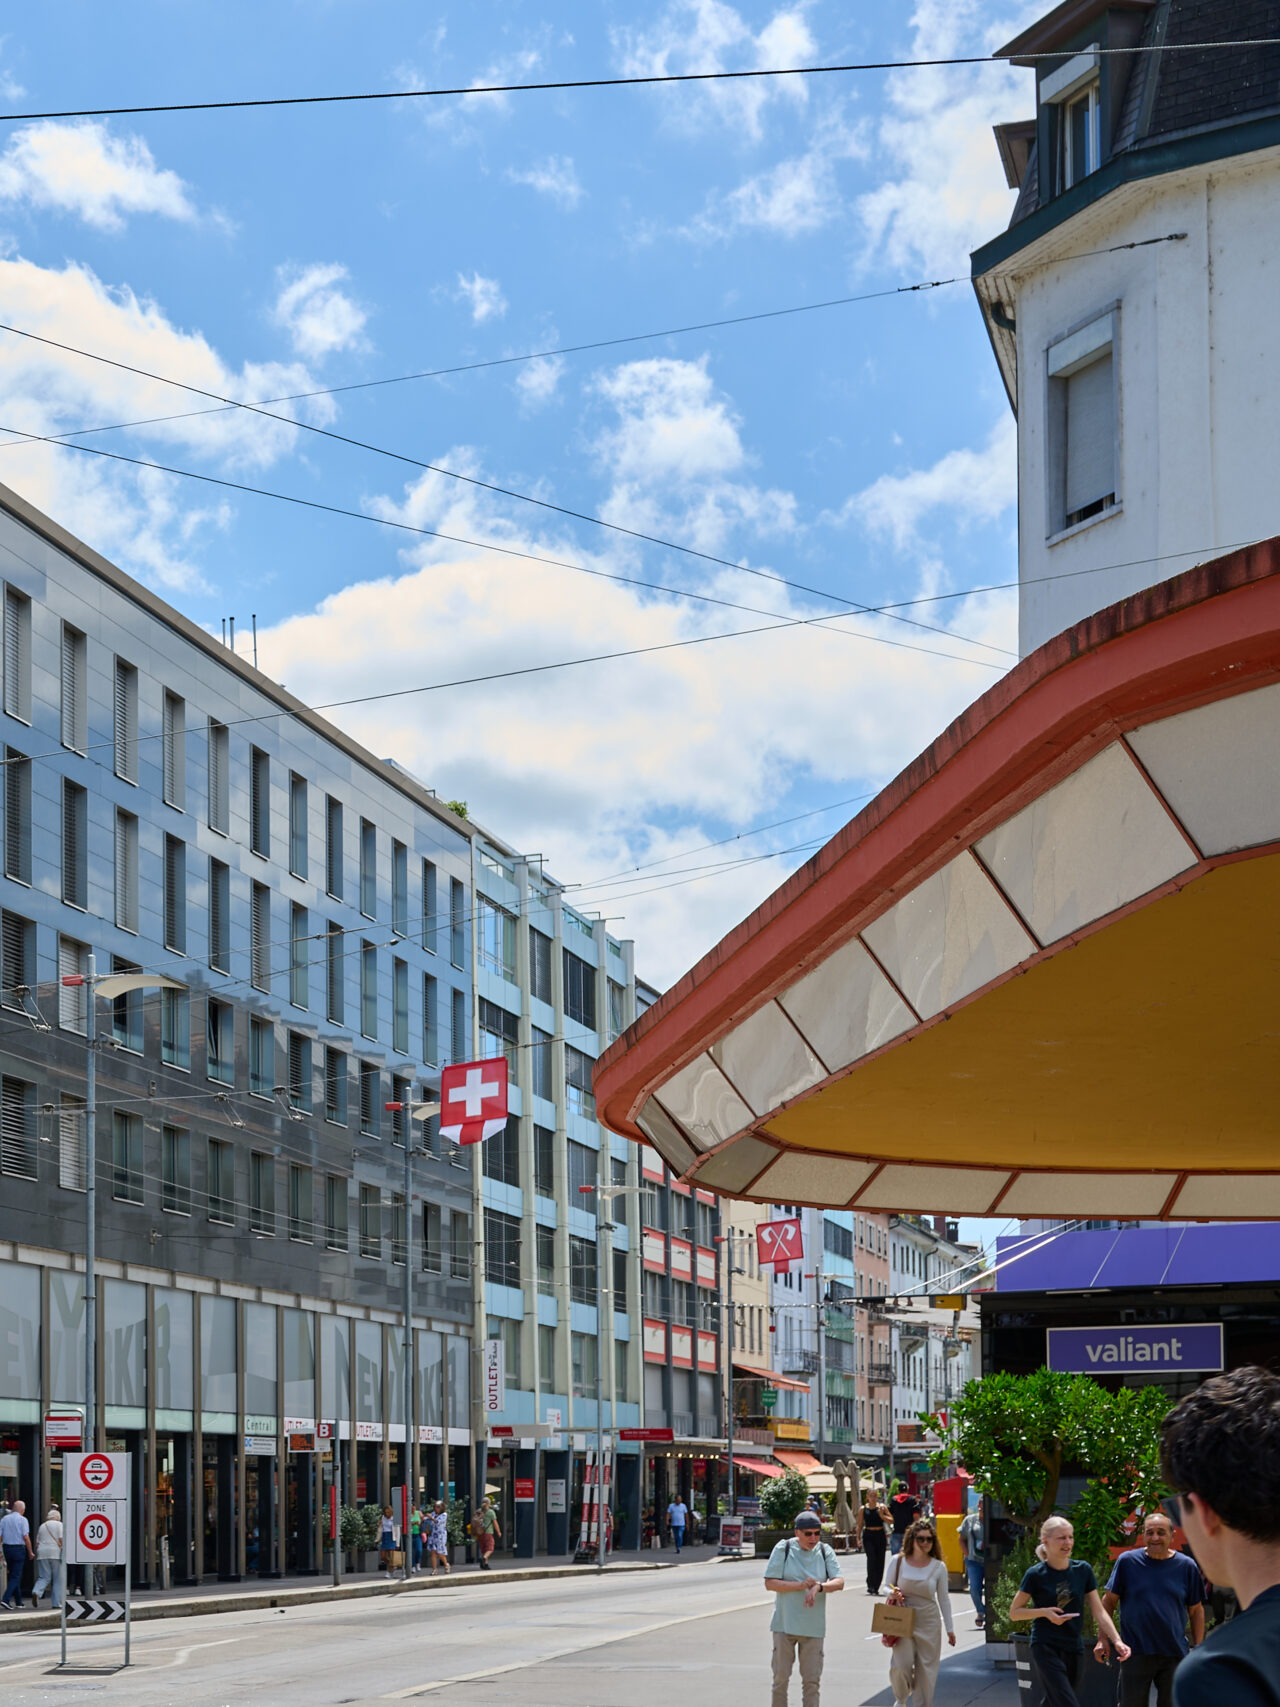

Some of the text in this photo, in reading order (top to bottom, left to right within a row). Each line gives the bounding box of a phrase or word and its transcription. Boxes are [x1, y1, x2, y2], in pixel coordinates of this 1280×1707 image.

[1086, 1336, 1183, 1363] valiant
[488, 1366, 498, 1410] OUTLET
[246, 1419, 272, 1431] Central
[319, 1424, 329, 1437] B
[86, 1504, 107, 1512] ZONE
[88, 1525, 104, 1539] 30
